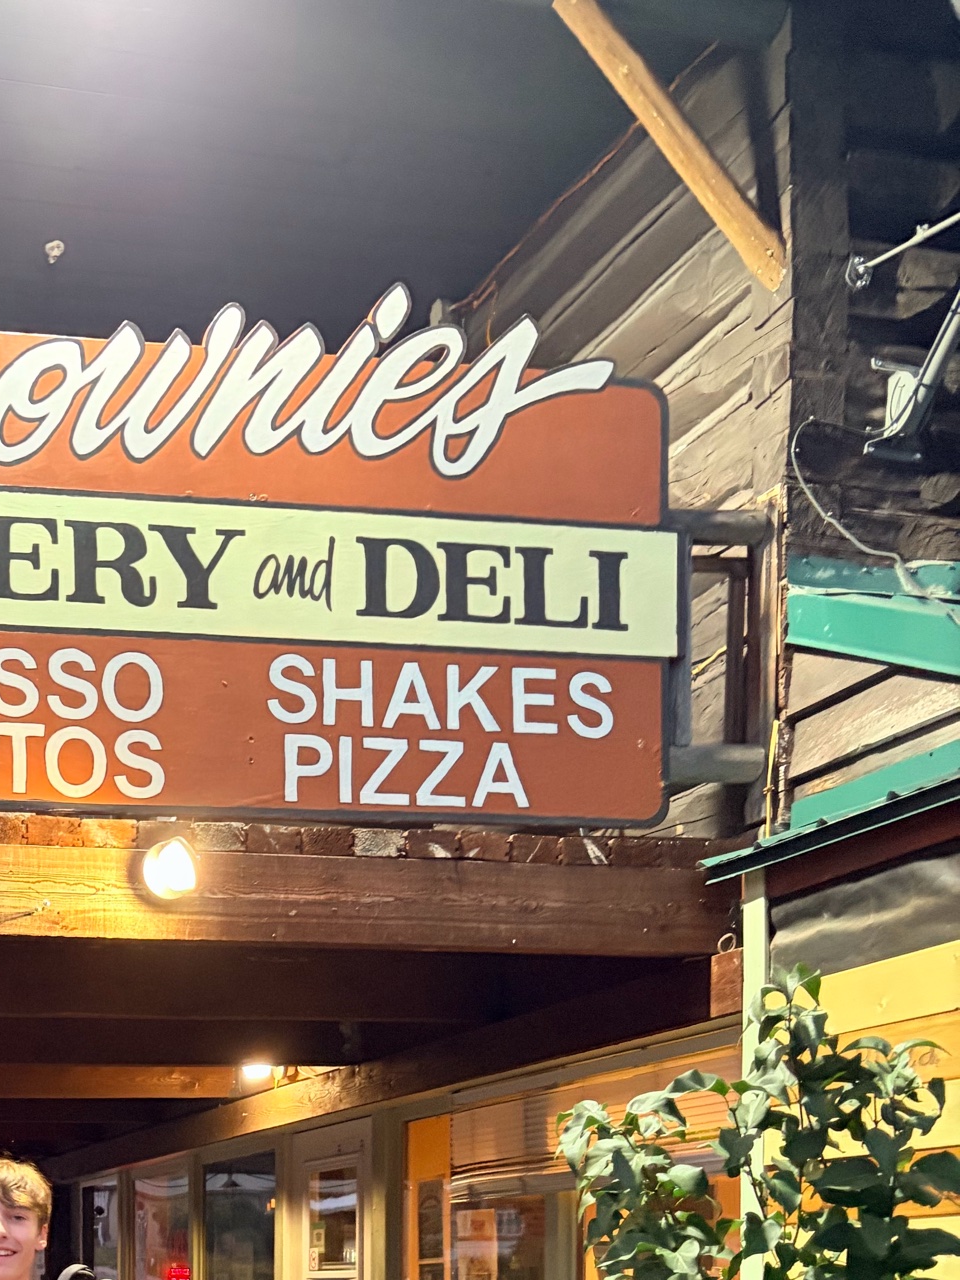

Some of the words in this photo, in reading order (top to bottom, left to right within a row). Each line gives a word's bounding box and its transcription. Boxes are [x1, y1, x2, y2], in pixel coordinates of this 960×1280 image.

[253, 535, 335, 612] and
[355, 536, 629, 632] DELI
[267, 653, 615, 739] SHAKES
[283, 733, 530, 808] PIZZA
